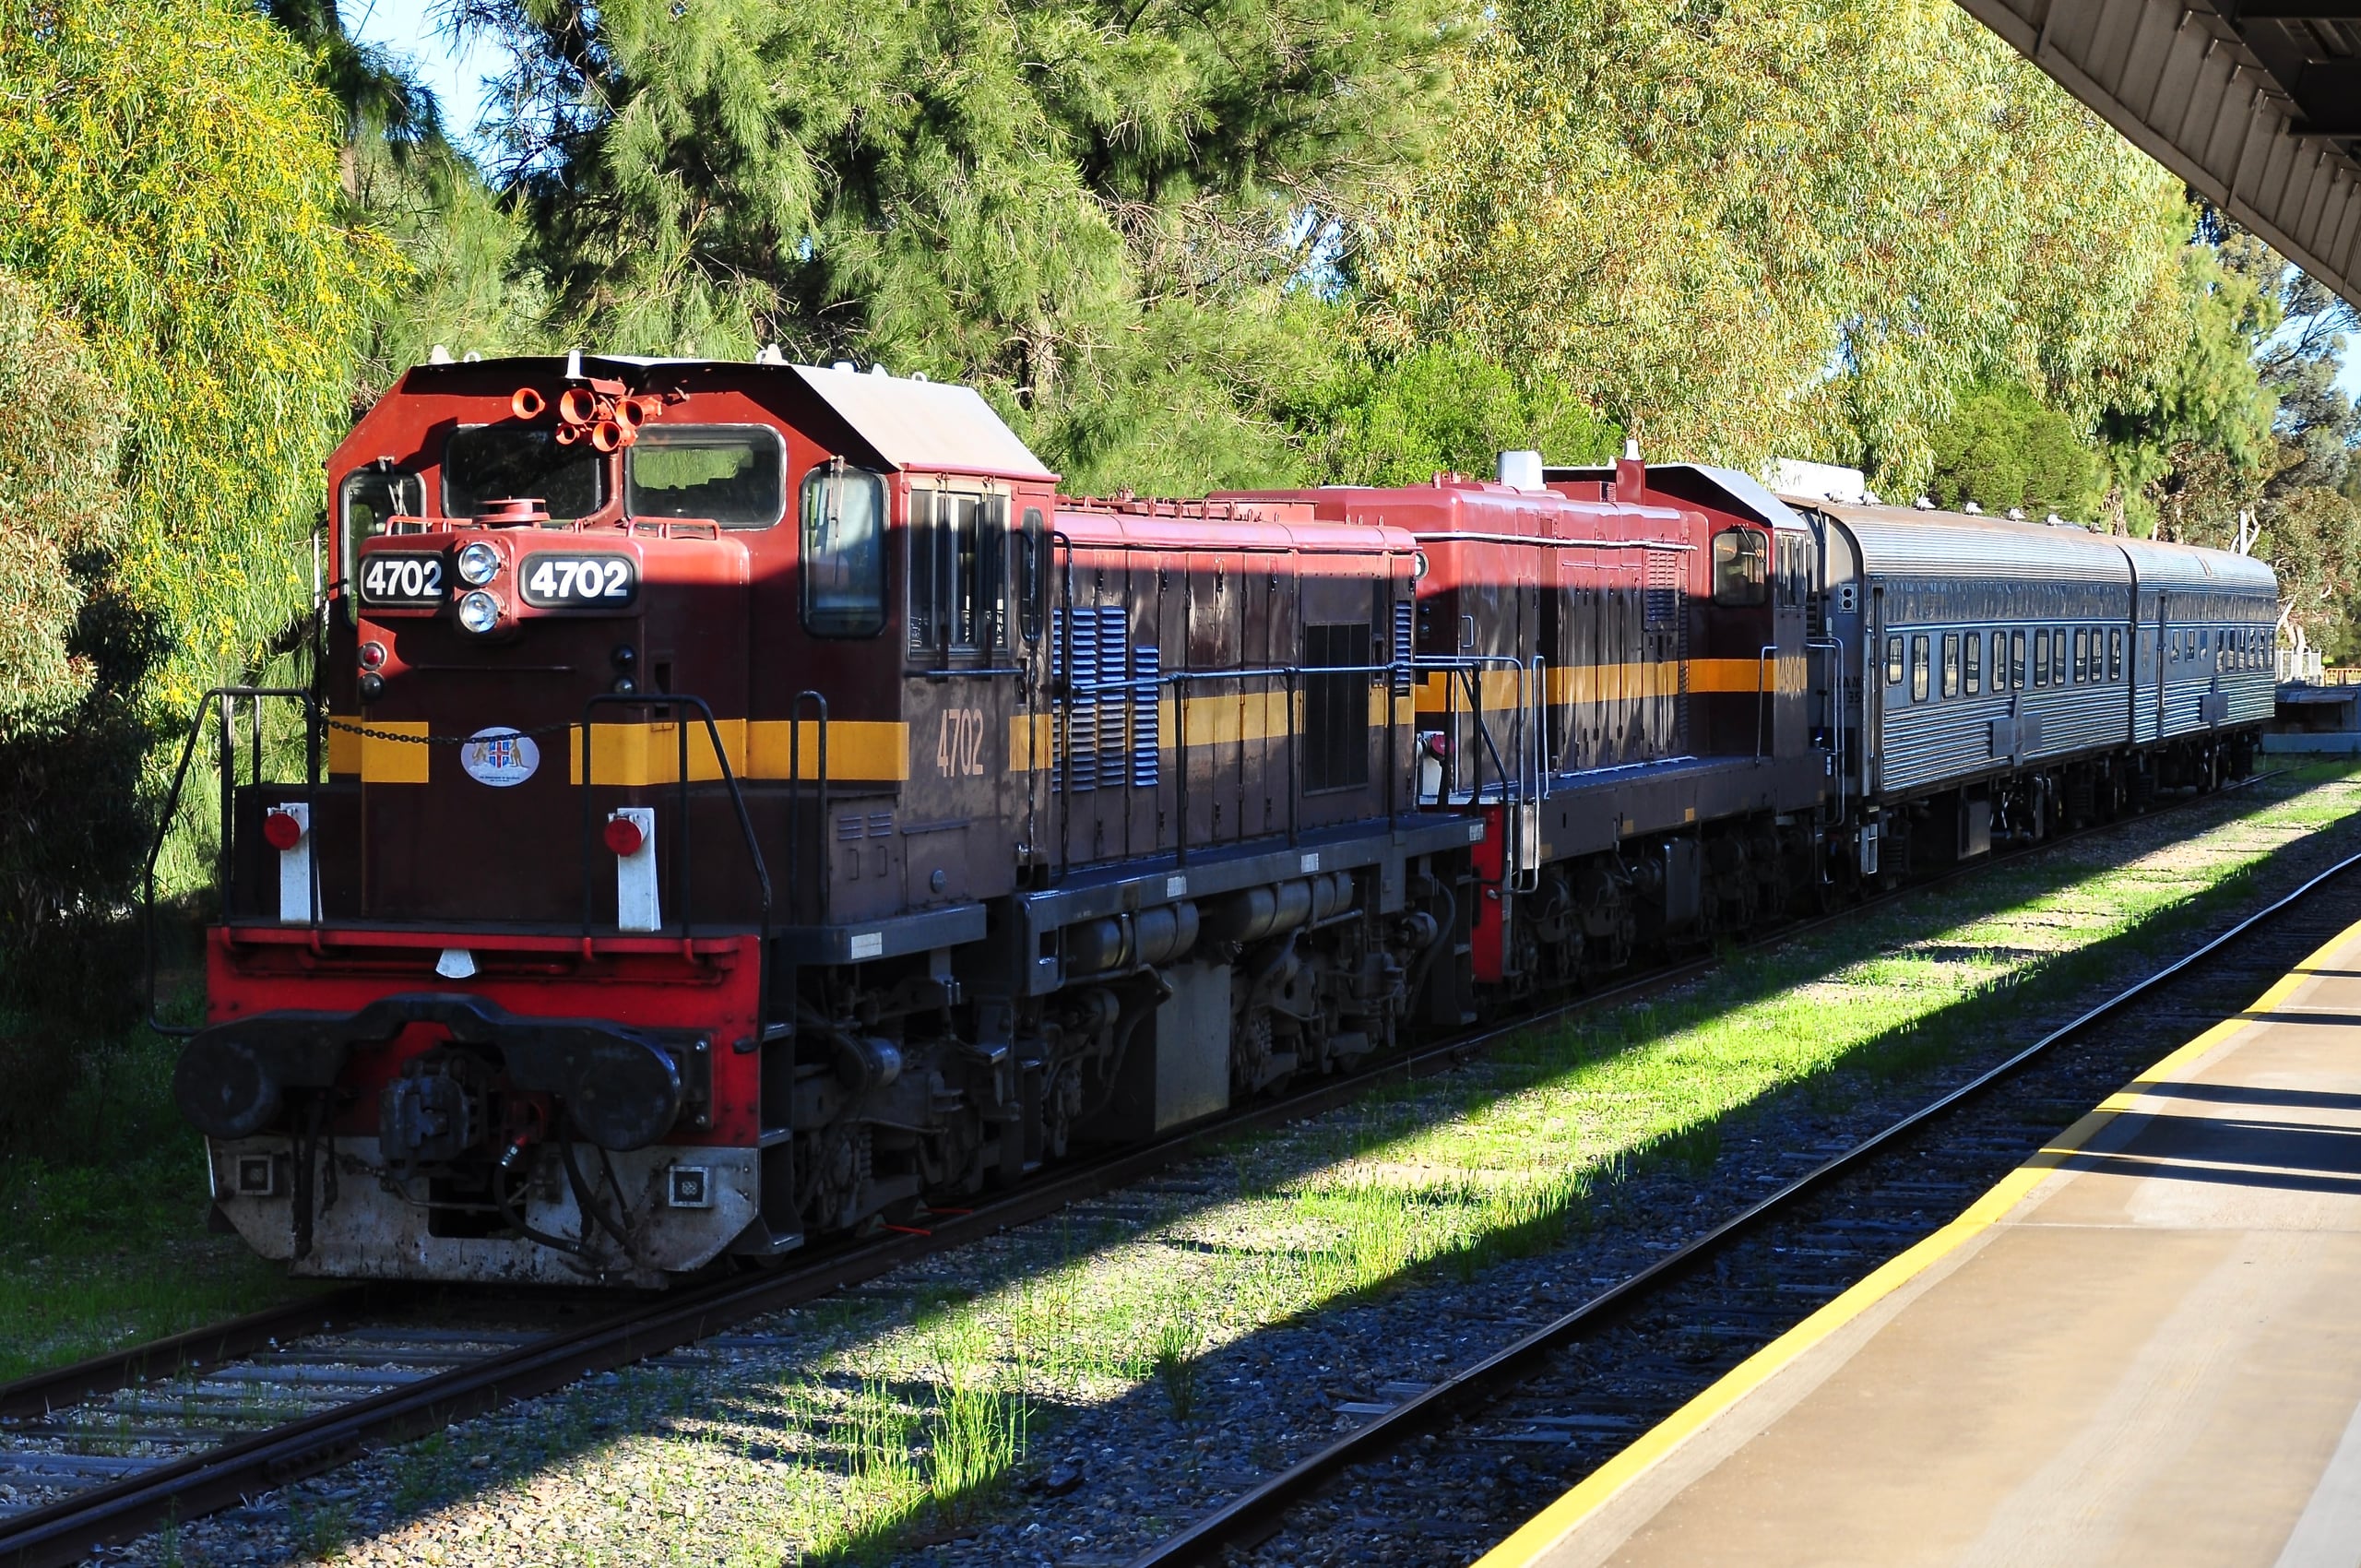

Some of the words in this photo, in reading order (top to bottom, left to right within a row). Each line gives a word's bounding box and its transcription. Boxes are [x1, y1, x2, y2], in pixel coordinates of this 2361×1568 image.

[366, 561, 442, 596] 4702
[530, 561, 628, 599] 4702
[937, 708, 984, 778] 4702
